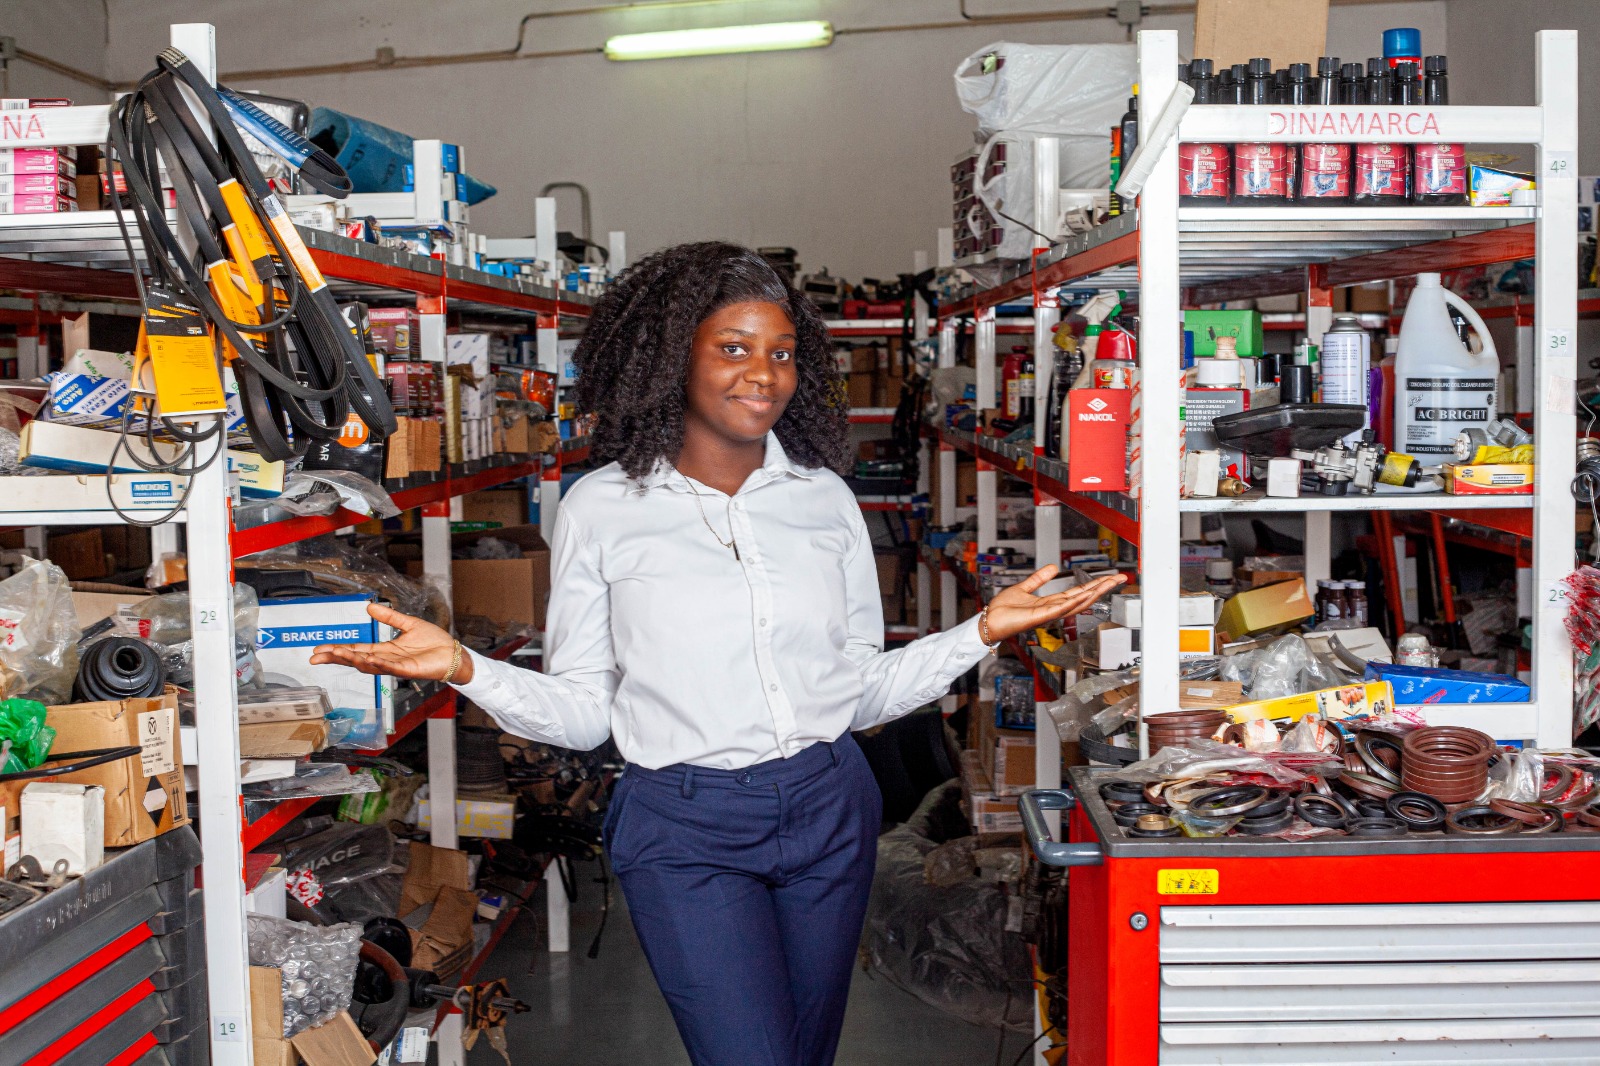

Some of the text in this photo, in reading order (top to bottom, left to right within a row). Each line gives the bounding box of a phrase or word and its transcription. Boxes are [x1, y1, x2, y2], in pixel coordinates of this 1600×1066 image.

[1270, 112, 1440, 135] DINAMARCA
[1078, 413, 1116, 422] NAKOL
[1417, 409, 1487, 420] AC BRIGHT
[200, 610, 216, 624] 2º
[282, 630, 360, 642] BRAKE SHOE
[220, 1022, 236, 1036] 1º
